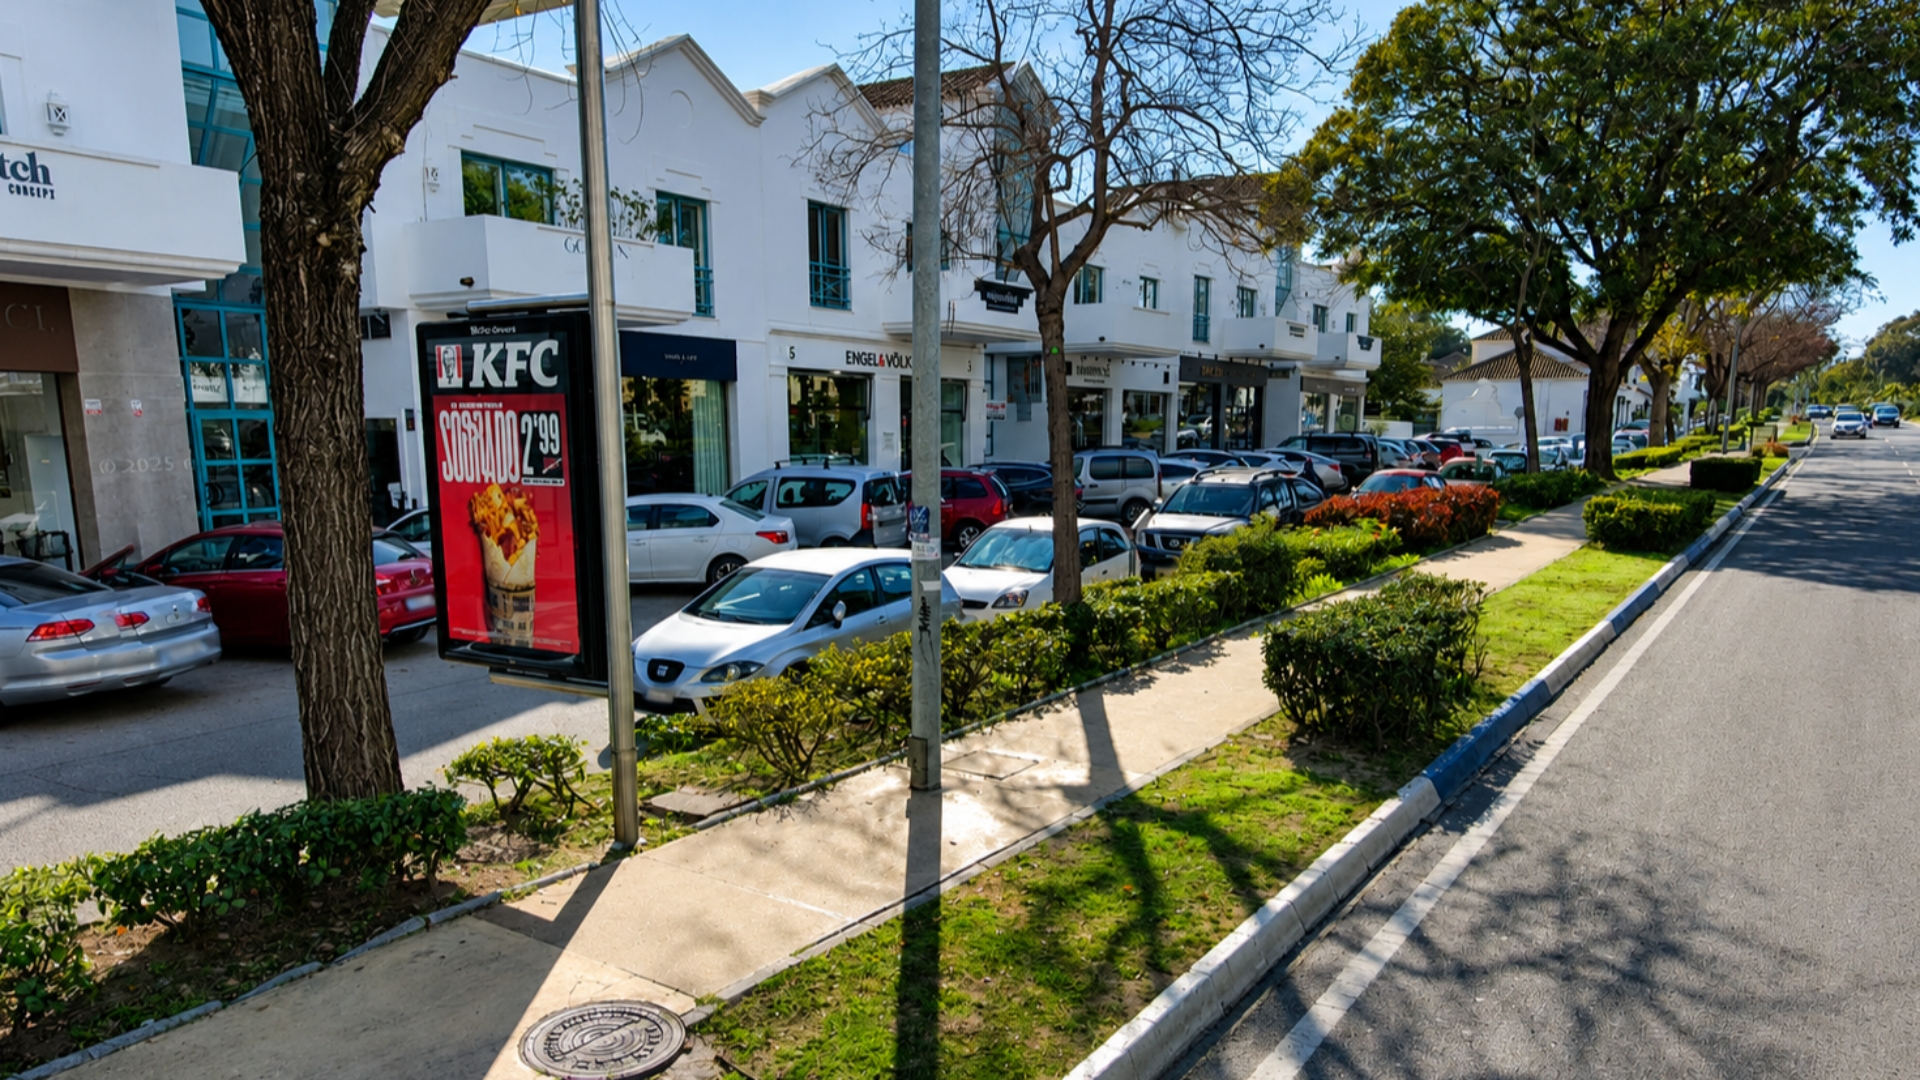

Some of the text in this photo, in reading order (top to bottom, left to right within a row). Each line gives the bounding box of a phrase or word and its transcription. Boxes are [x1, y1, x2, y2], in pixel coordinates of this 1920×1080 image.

[0, 151, 54, 186] tch
[469, 339, 559, 388] KFC
[789, 346, 796, 360] 5
